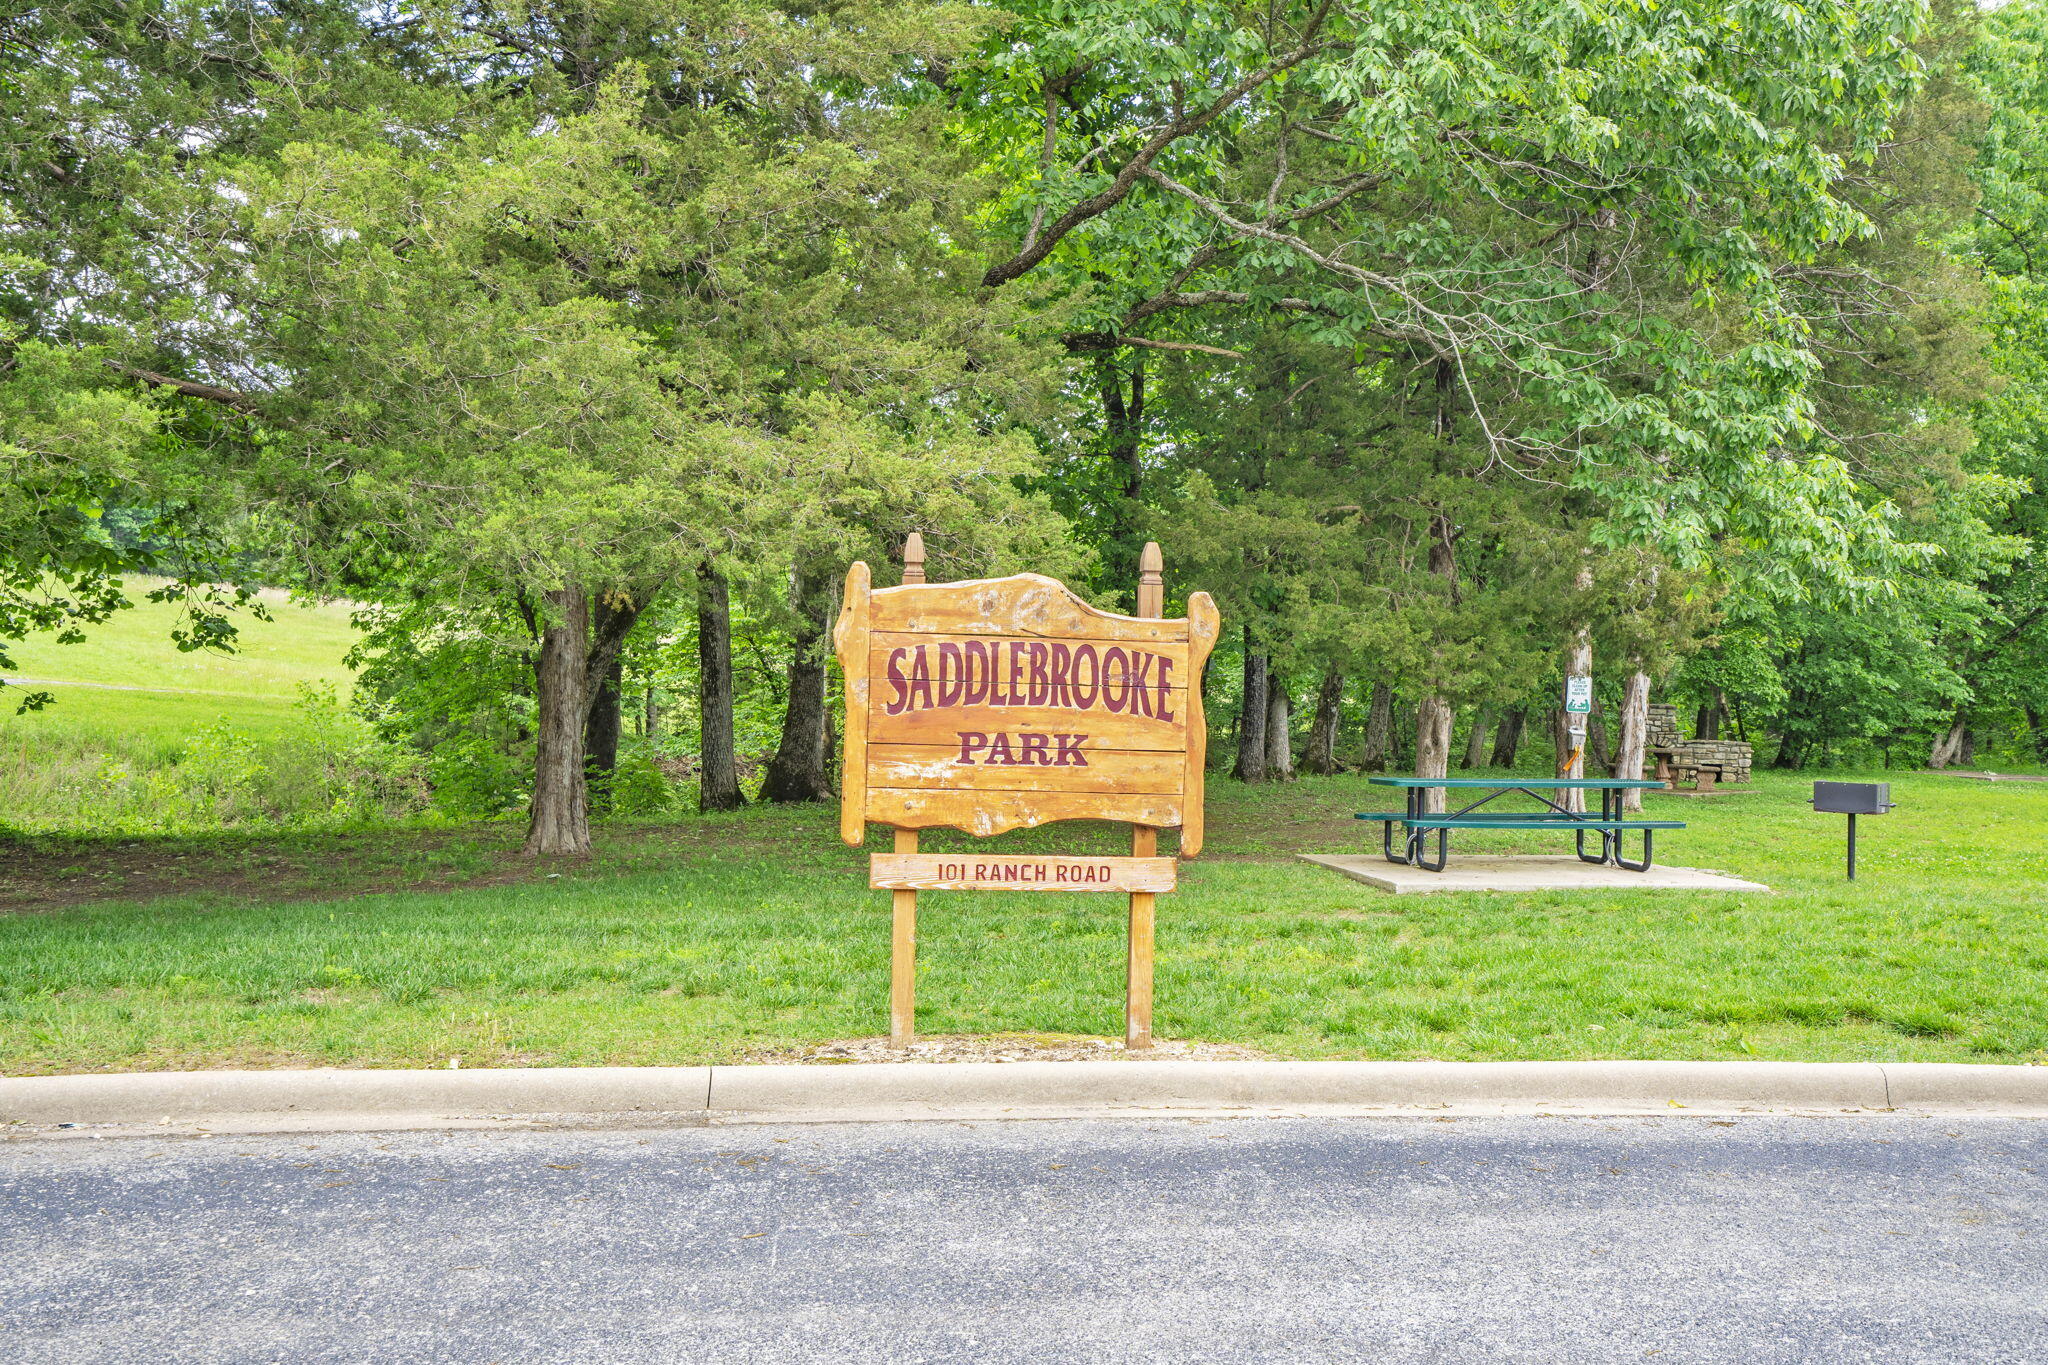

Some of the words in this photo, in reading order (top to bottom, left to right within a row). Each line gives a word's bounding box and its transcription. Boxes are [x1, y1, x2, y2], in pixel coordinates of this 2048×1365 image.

[886, 640, 1175, 722] SADDLEBROOKE
[956, 731, 1089, 766] PARK
[938, 863, 966, 880] 101
[975, 863, 1046, 882] RANCH
[1056, 864, 1111, 883] ROAD
